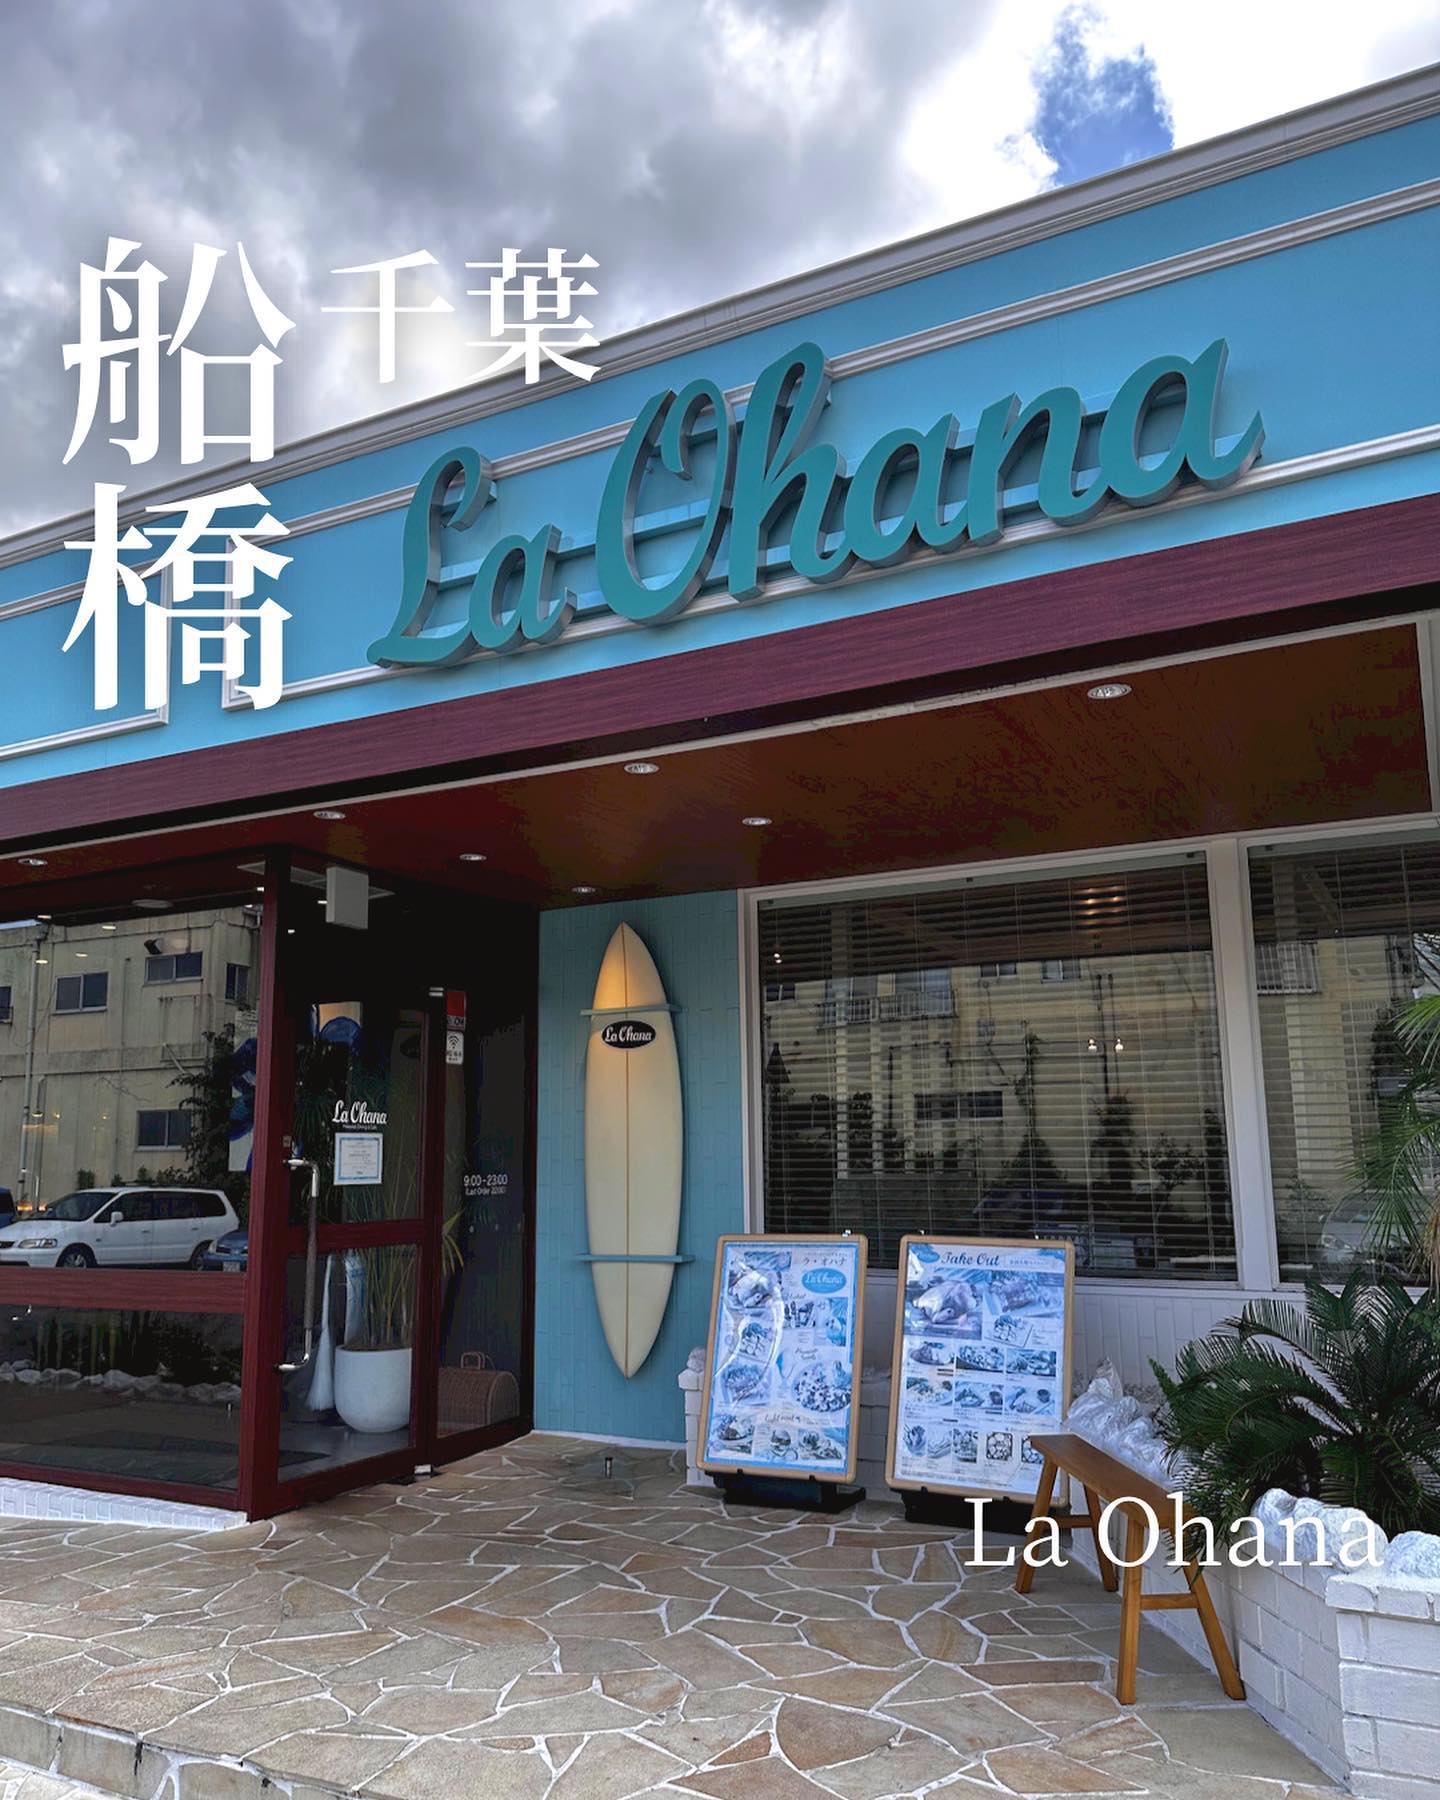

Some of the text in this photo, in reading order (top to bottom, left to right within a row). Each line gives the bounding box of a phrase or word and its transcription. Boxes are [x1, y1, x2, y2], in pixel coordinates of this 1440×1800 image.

[367, 338, 1267, 669] La Ohana
[605, 1025, 652, 1042] La Ohana
[332, 1099, 388, 1124] La Ohana
[941, 1251, 974, 1265] Take
[976, 1252, 1000, 1266] Out
